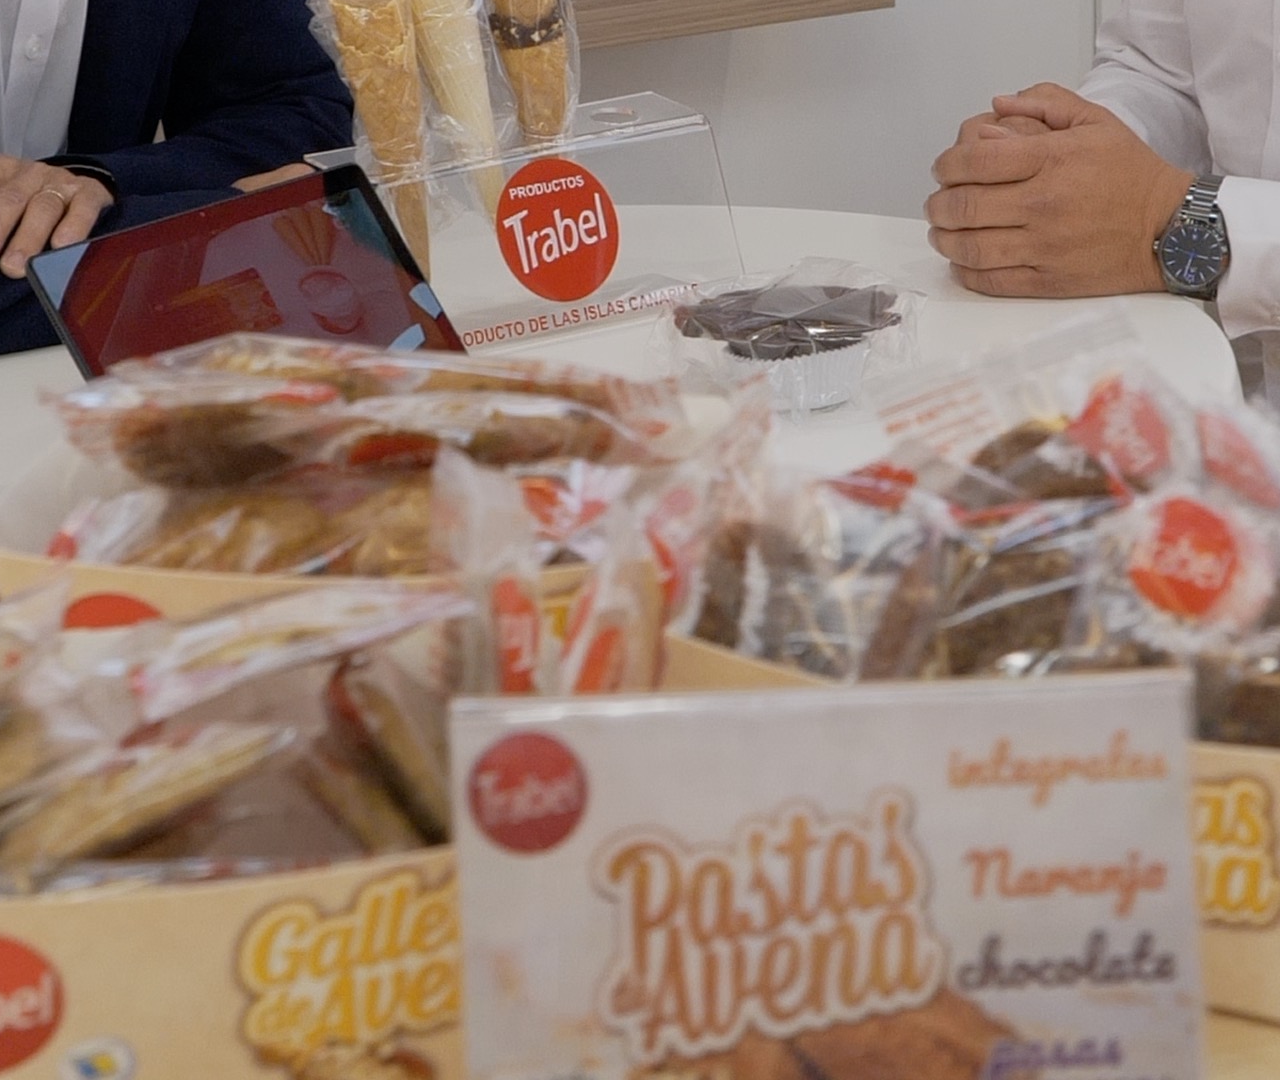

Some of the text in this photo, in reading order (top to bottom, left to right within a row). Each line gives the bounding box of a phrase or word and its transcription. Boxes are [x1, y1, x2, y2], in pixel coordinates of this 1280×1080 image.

[508, 174, 585, 201] PRODUCTOS
[503, 192, 609, 275] Trabel
[463, 321, 525, 347] ODUCTO
[529, 315, 550, 333] DE
[552, 309, 581, 328] LAS
[584, 300, 626, 321] ISLAS
[947, 728, 1168, 807] integrales
[609, 801, 917, 974] Pastas
[964, 846, 1168, 919] Naranja
[252, 884, 460, 986] Galle
[955, 927, 1177, 992] chocolate
[304, 960, 460, 1047] Ave
[642, 912, 927, 1051] Avena
